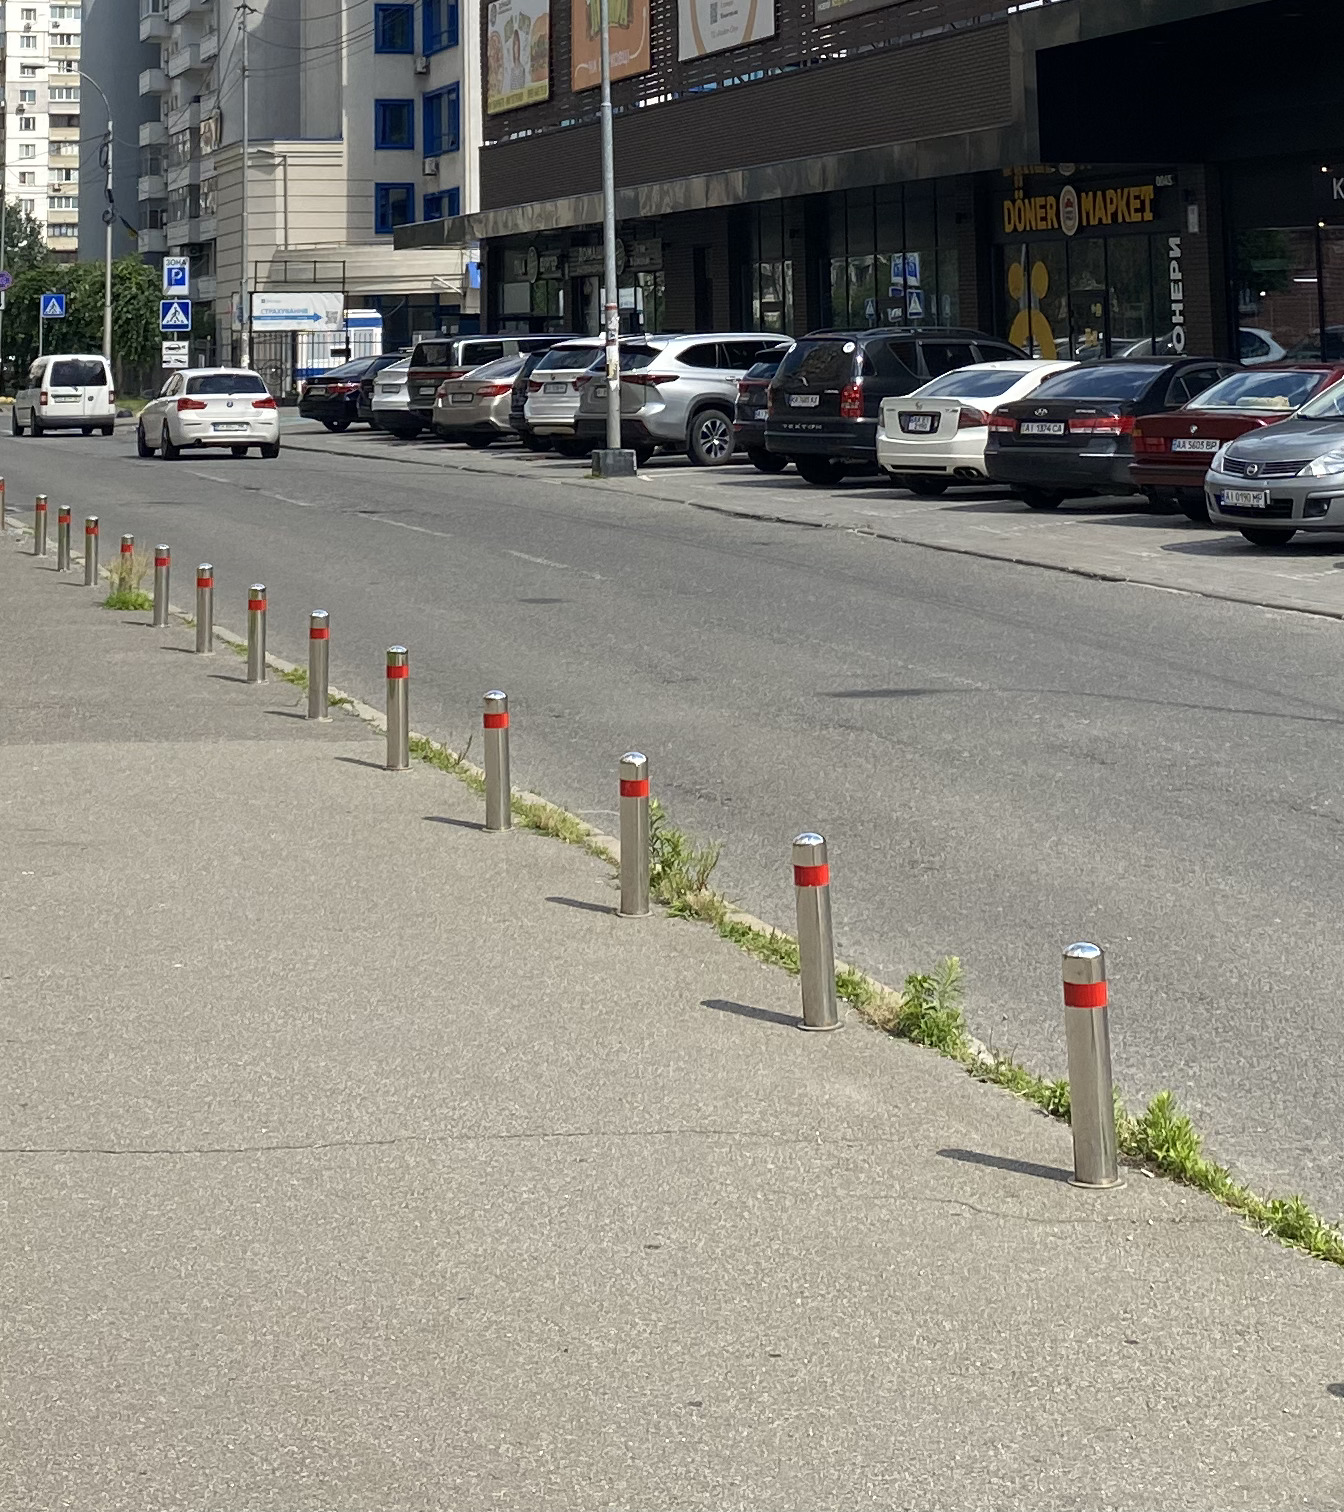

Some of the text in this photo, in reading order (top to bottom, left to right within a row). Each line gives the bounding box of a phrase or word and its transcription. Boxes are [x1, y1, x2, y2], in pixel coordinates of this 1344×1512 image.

[1004, 189, 1058, 232] DÖNER
[1081, 185, 1154, 226] МАРКЕТ
[165, 258, 188, 267] ЗОНА
[1168, 237, 1186, 354] ОНЕРИ
